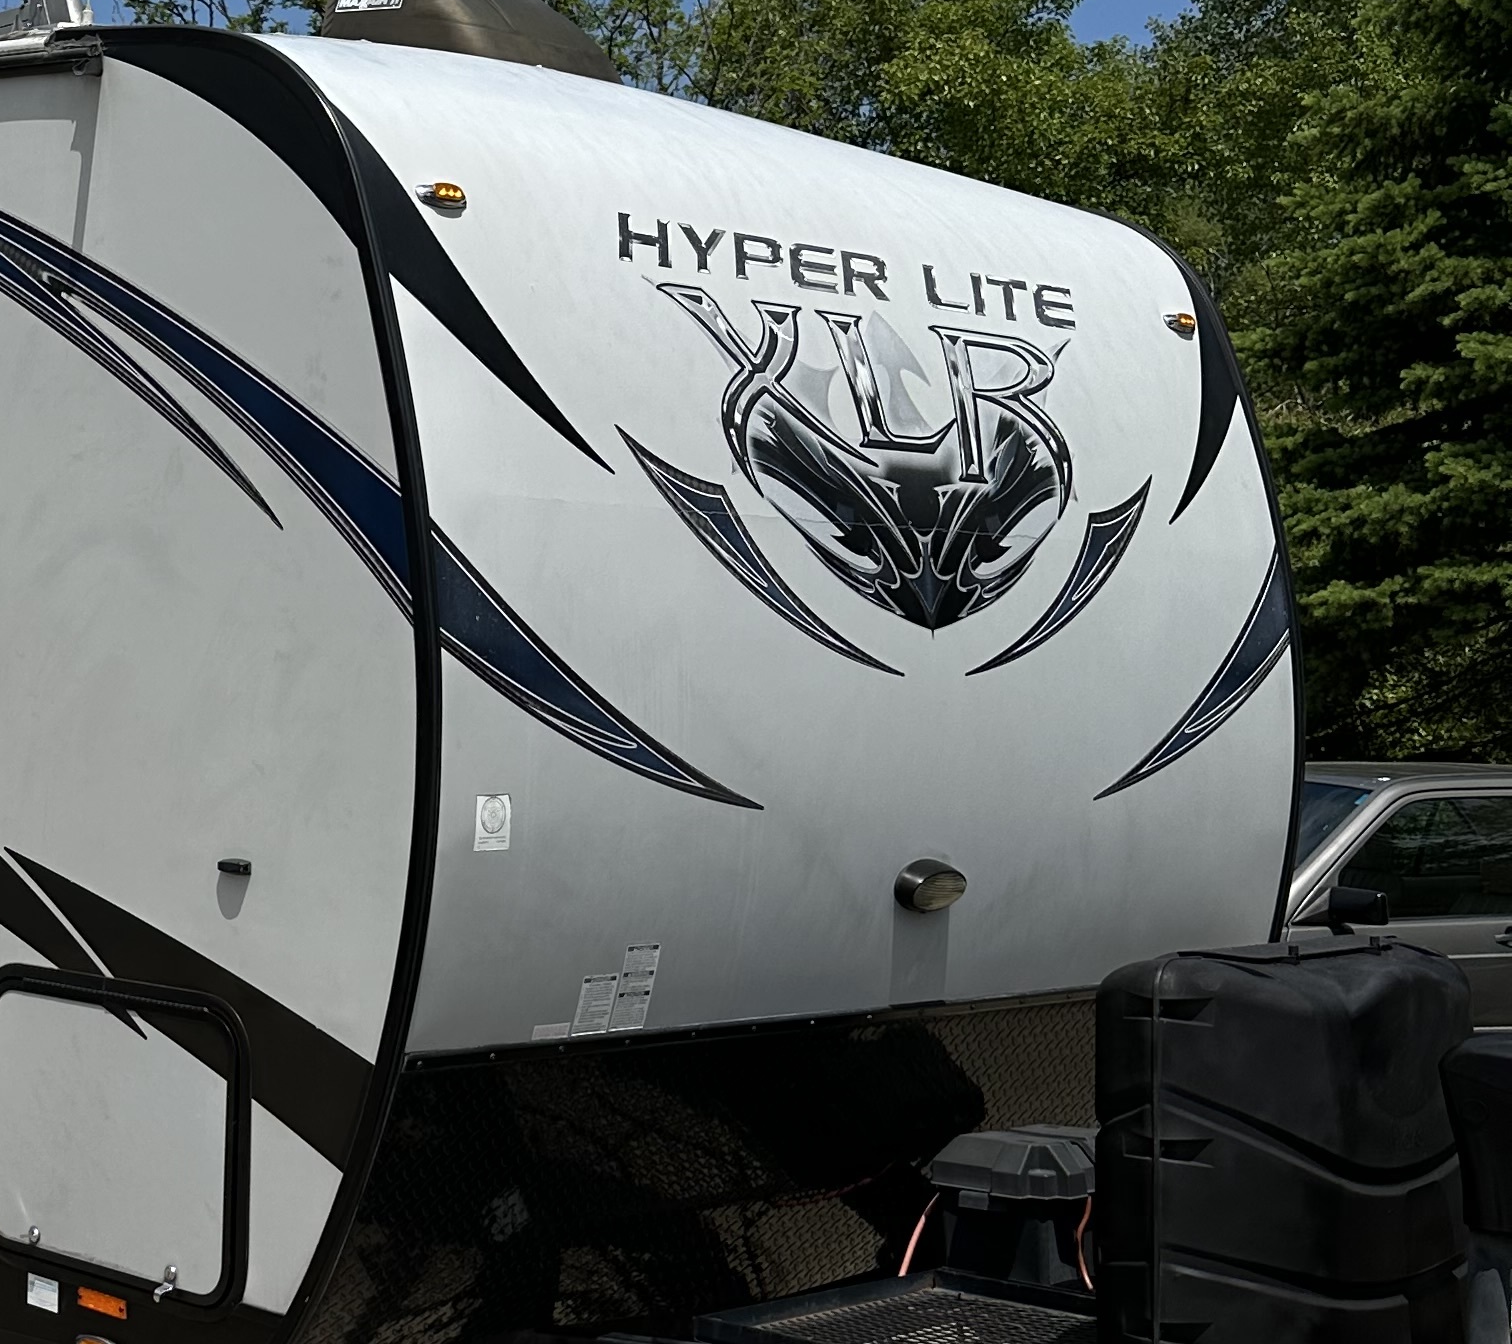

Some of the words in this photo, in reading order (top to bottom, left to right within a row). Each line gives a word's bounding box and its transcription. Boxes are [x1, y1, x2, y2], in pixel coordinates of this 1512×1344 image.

[617, 211, 889, 301] HYPER
[922, 264, 1077, 330] LITE
[656, 282, 1071, 520] XLR
